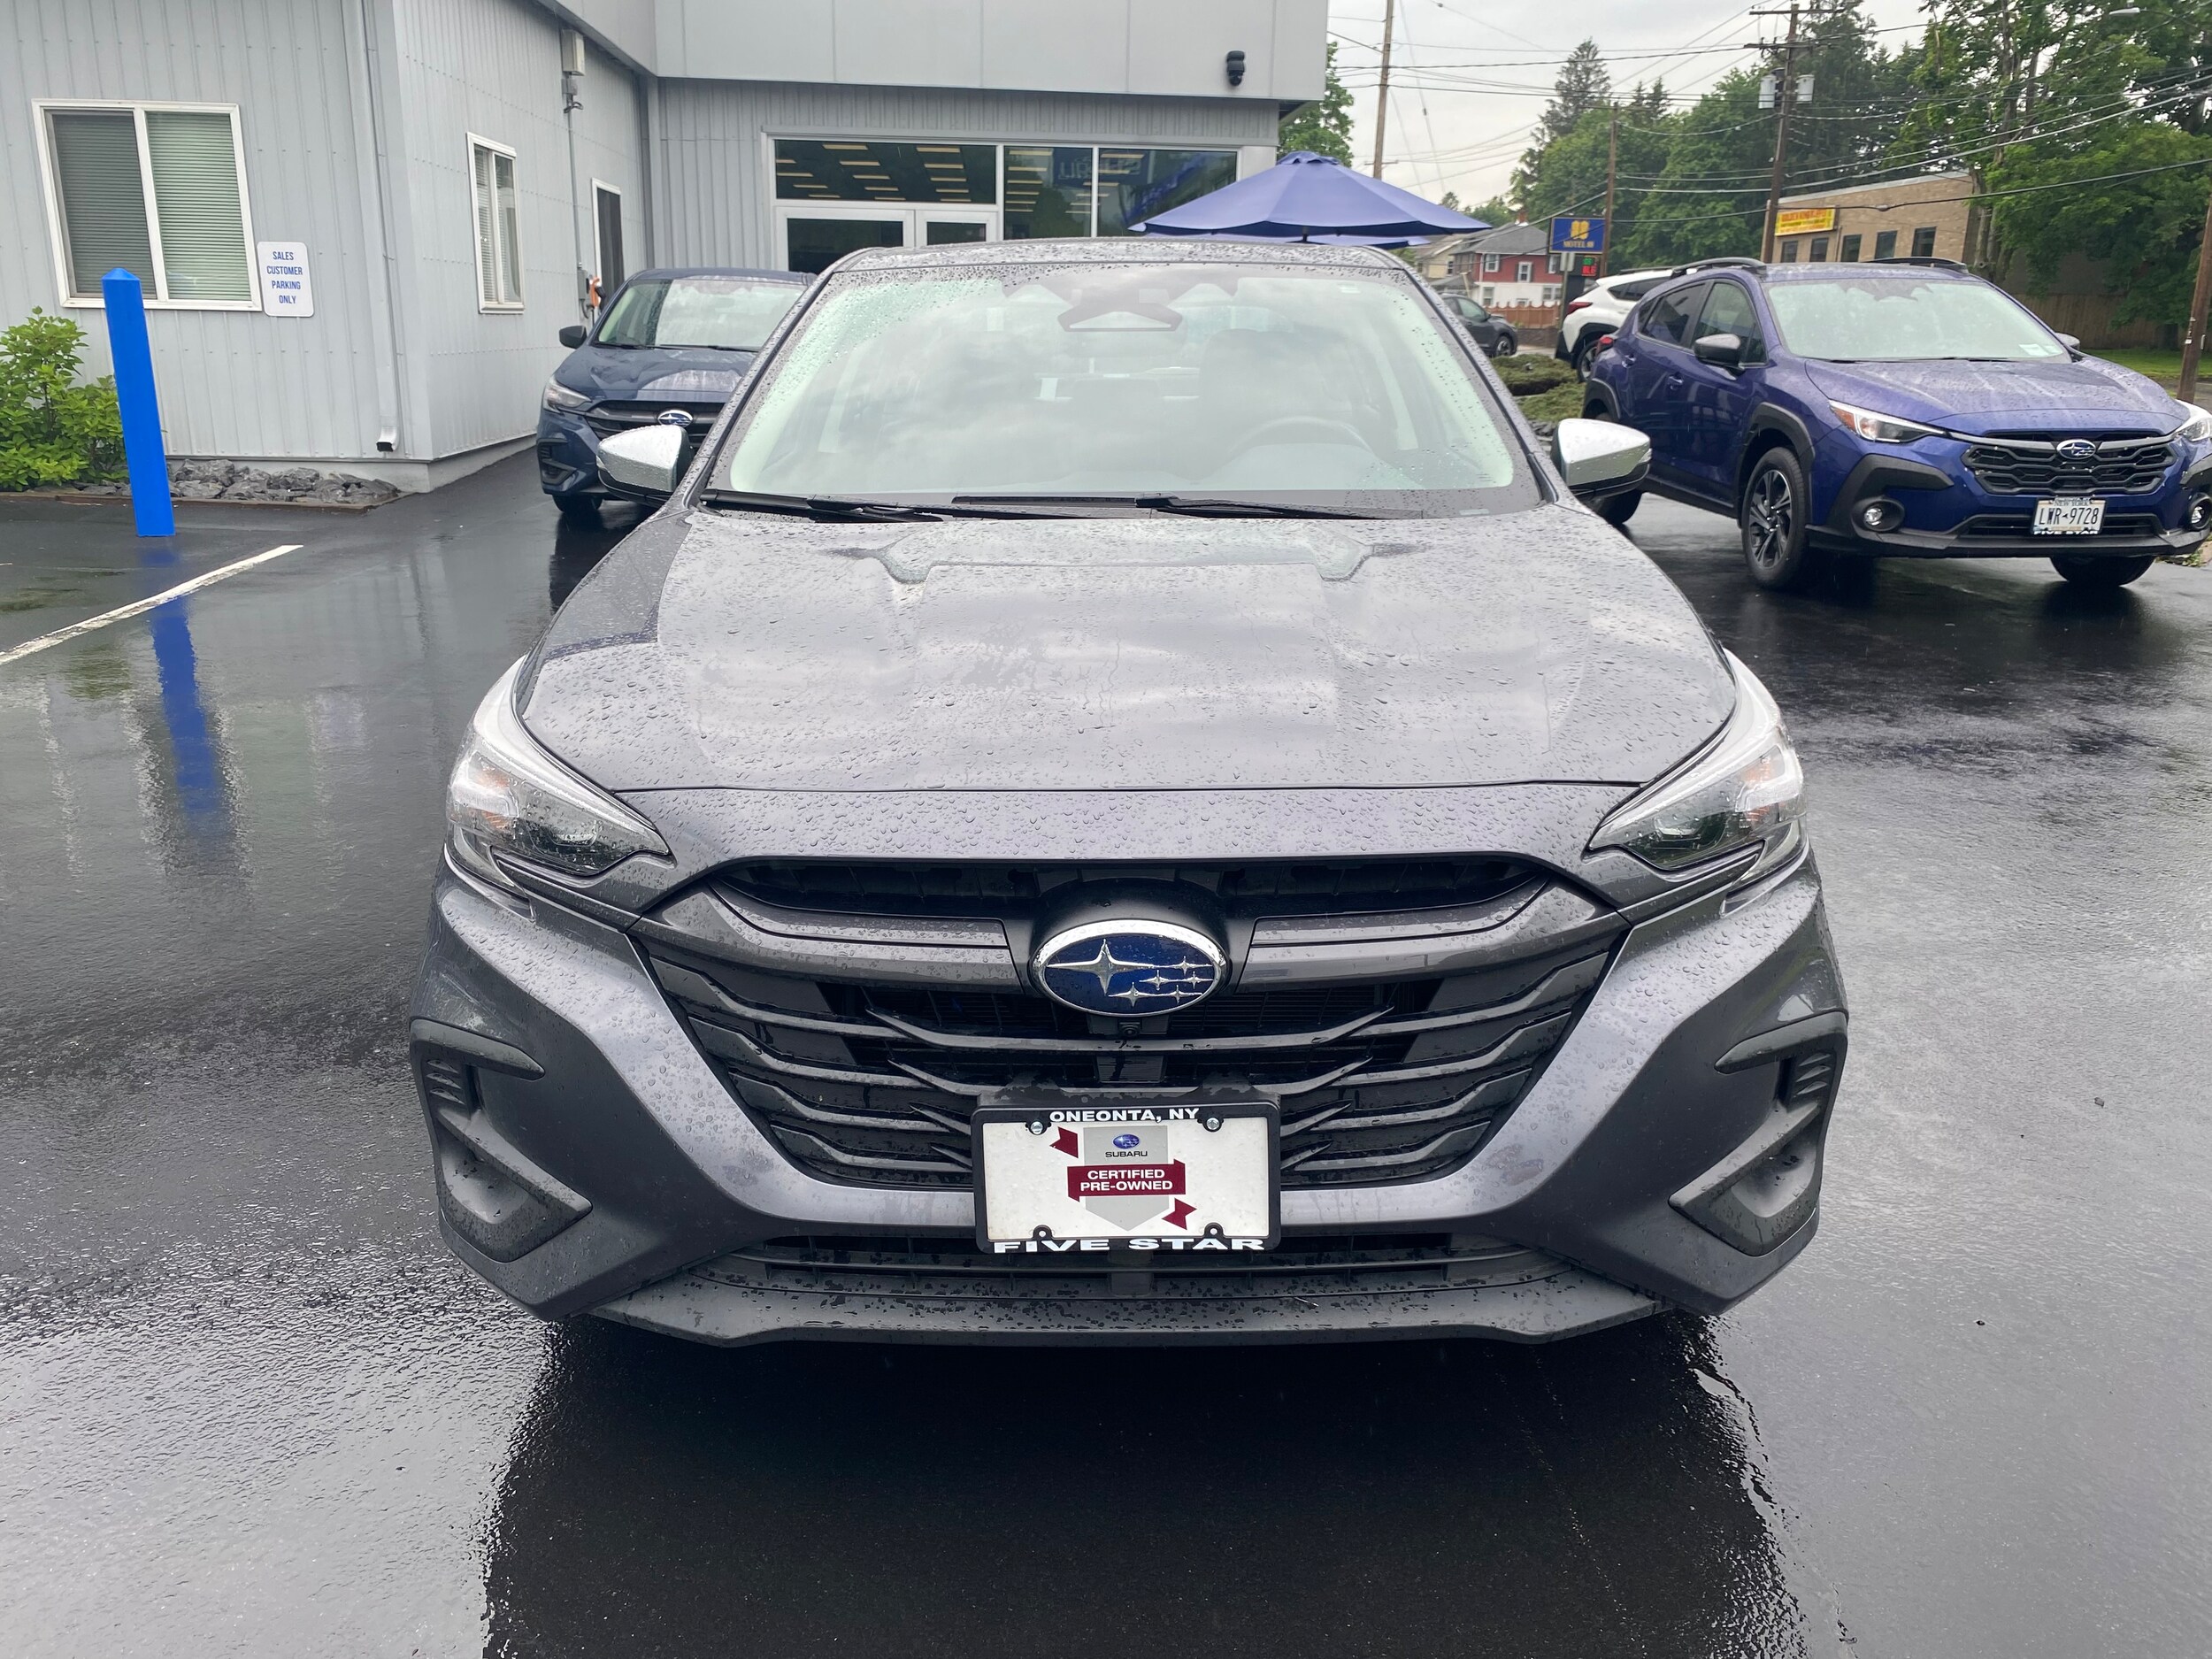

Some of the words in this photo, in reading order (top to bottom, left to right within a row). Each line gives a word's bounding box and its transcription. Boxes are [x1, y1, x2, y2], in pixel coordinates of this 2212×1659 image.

[273, 251, 294, 260] SALES
[266, 265, 303, 275] CUSTOMER
[272, 280, 301, 289] PARKING
[279, 295, 296, 303] ONLY
[1049, 1109, 1162, 1123] ONEONTA,
[1169, 1108, 1199, 1120] NY
[1087, 1169, 1165, 1180] CERTIFIED
[1080, 1180, 1172, 1192] PRE-OWNED
[994, 1239, 1110, 1254] FIVE
[1128, 1238, 1264, 1251] STAR
